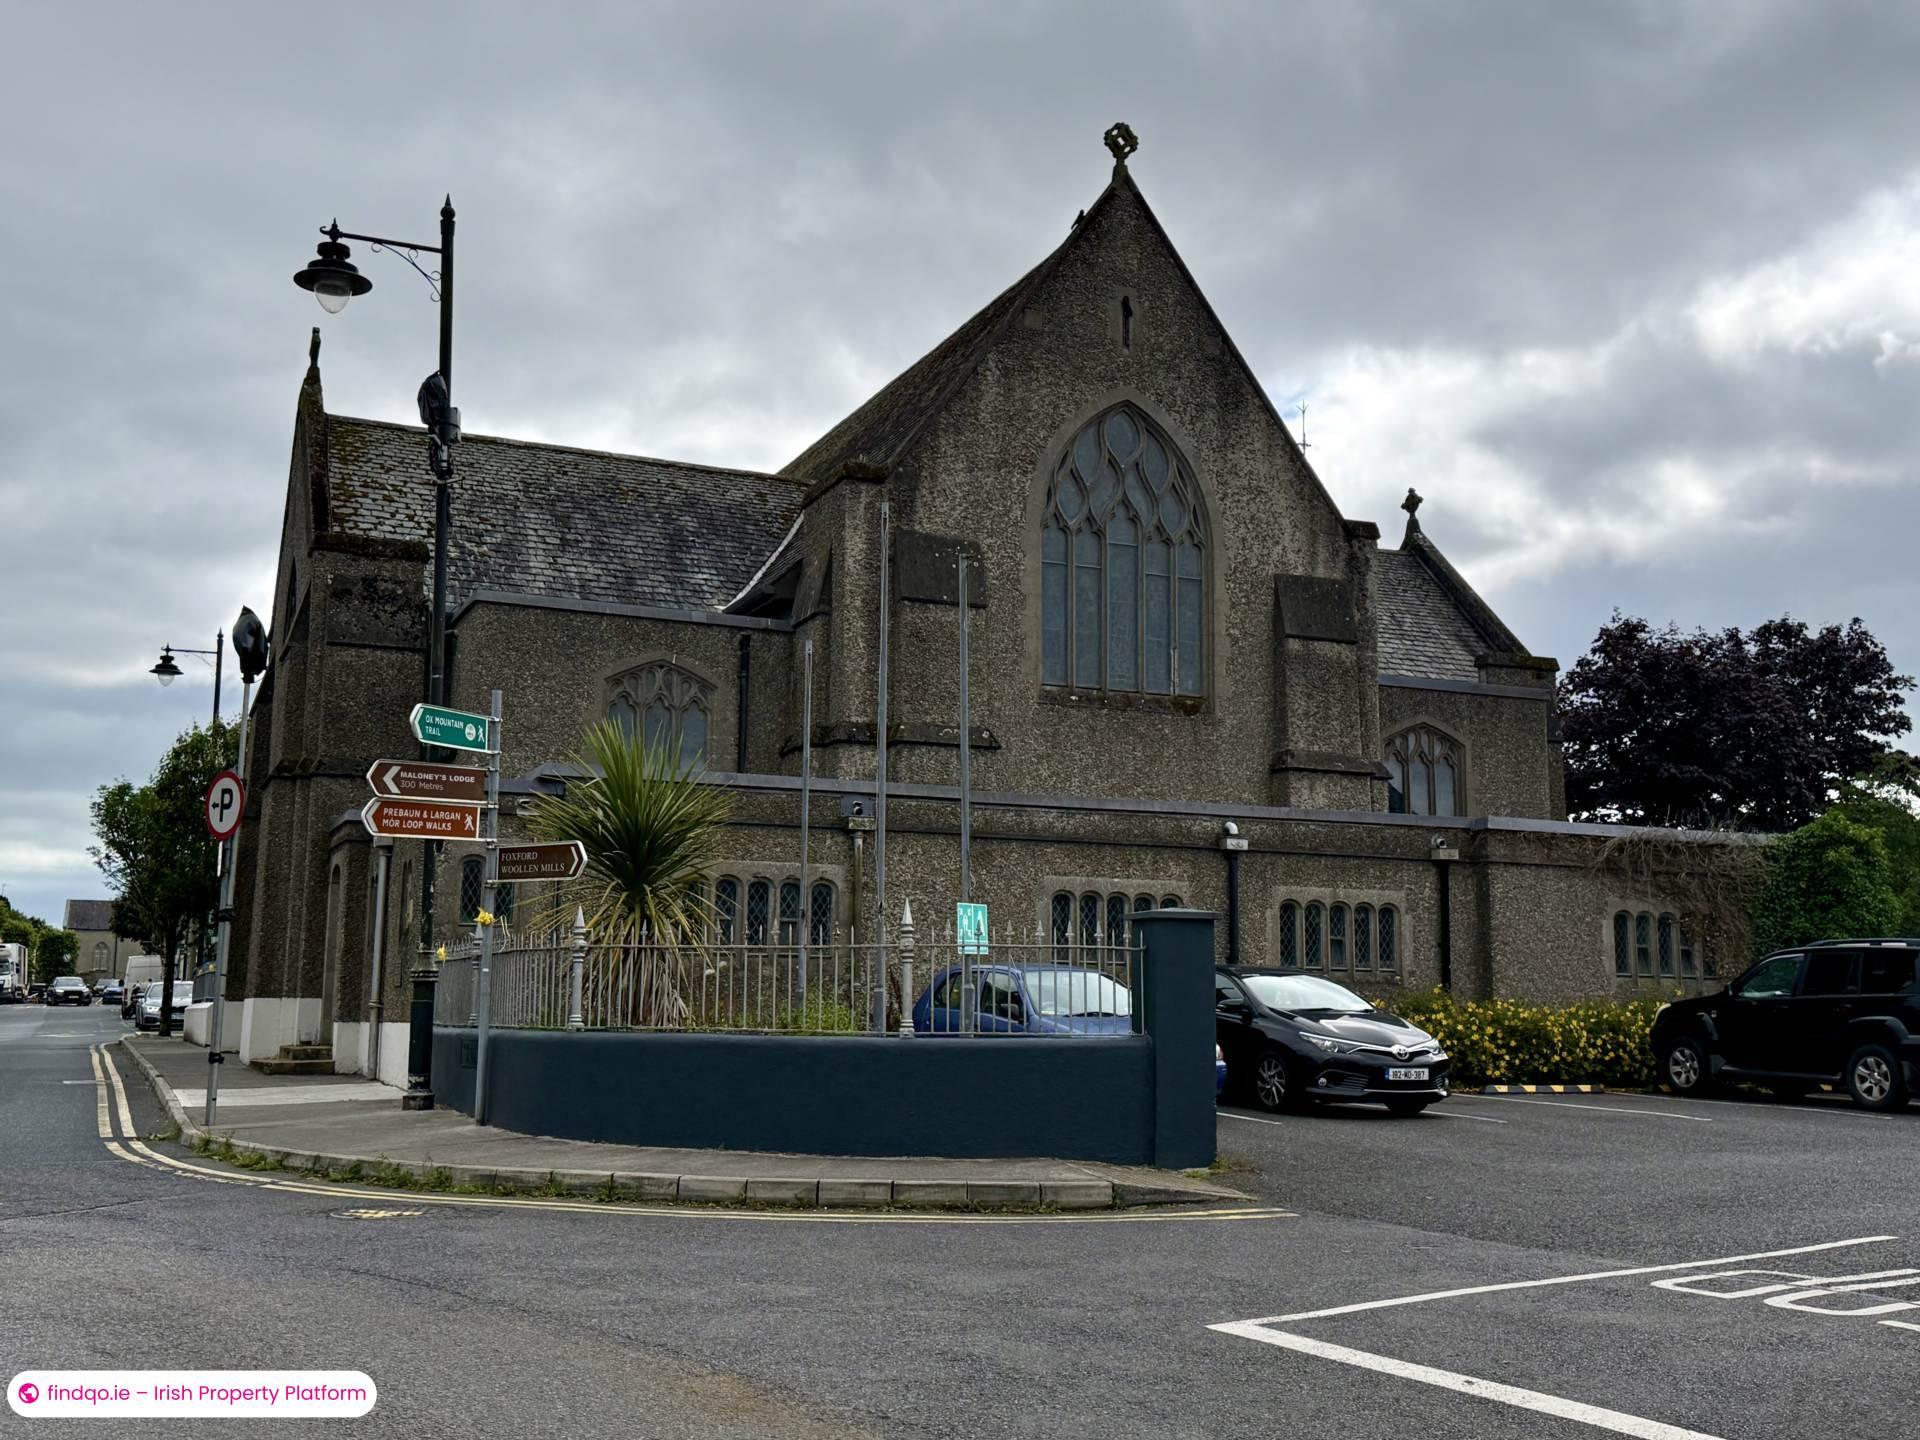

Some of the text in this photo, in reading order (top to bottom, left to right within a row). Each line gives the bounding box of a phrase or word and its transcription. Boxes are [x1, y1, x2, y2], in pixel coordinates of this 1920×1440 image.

[435, 716, 464, 729] MOUNTAIN
[425, 726, 441, 736] TRAIL
[400, 771, 475, 783] MALONEY'S LODGE
[400, 780, 444, 791] 300 Metres
[219, 788, 233, 822] P
[383, 807, 461, 821] PREBAUN & LARGAN
[402, 820, 424, 829] LOOP
[426, 821, 452, 831] WALKS
[501, 852, 538, 861] FOXFORD
[501, 863, 565, 873] WOOLLEN MILLS
